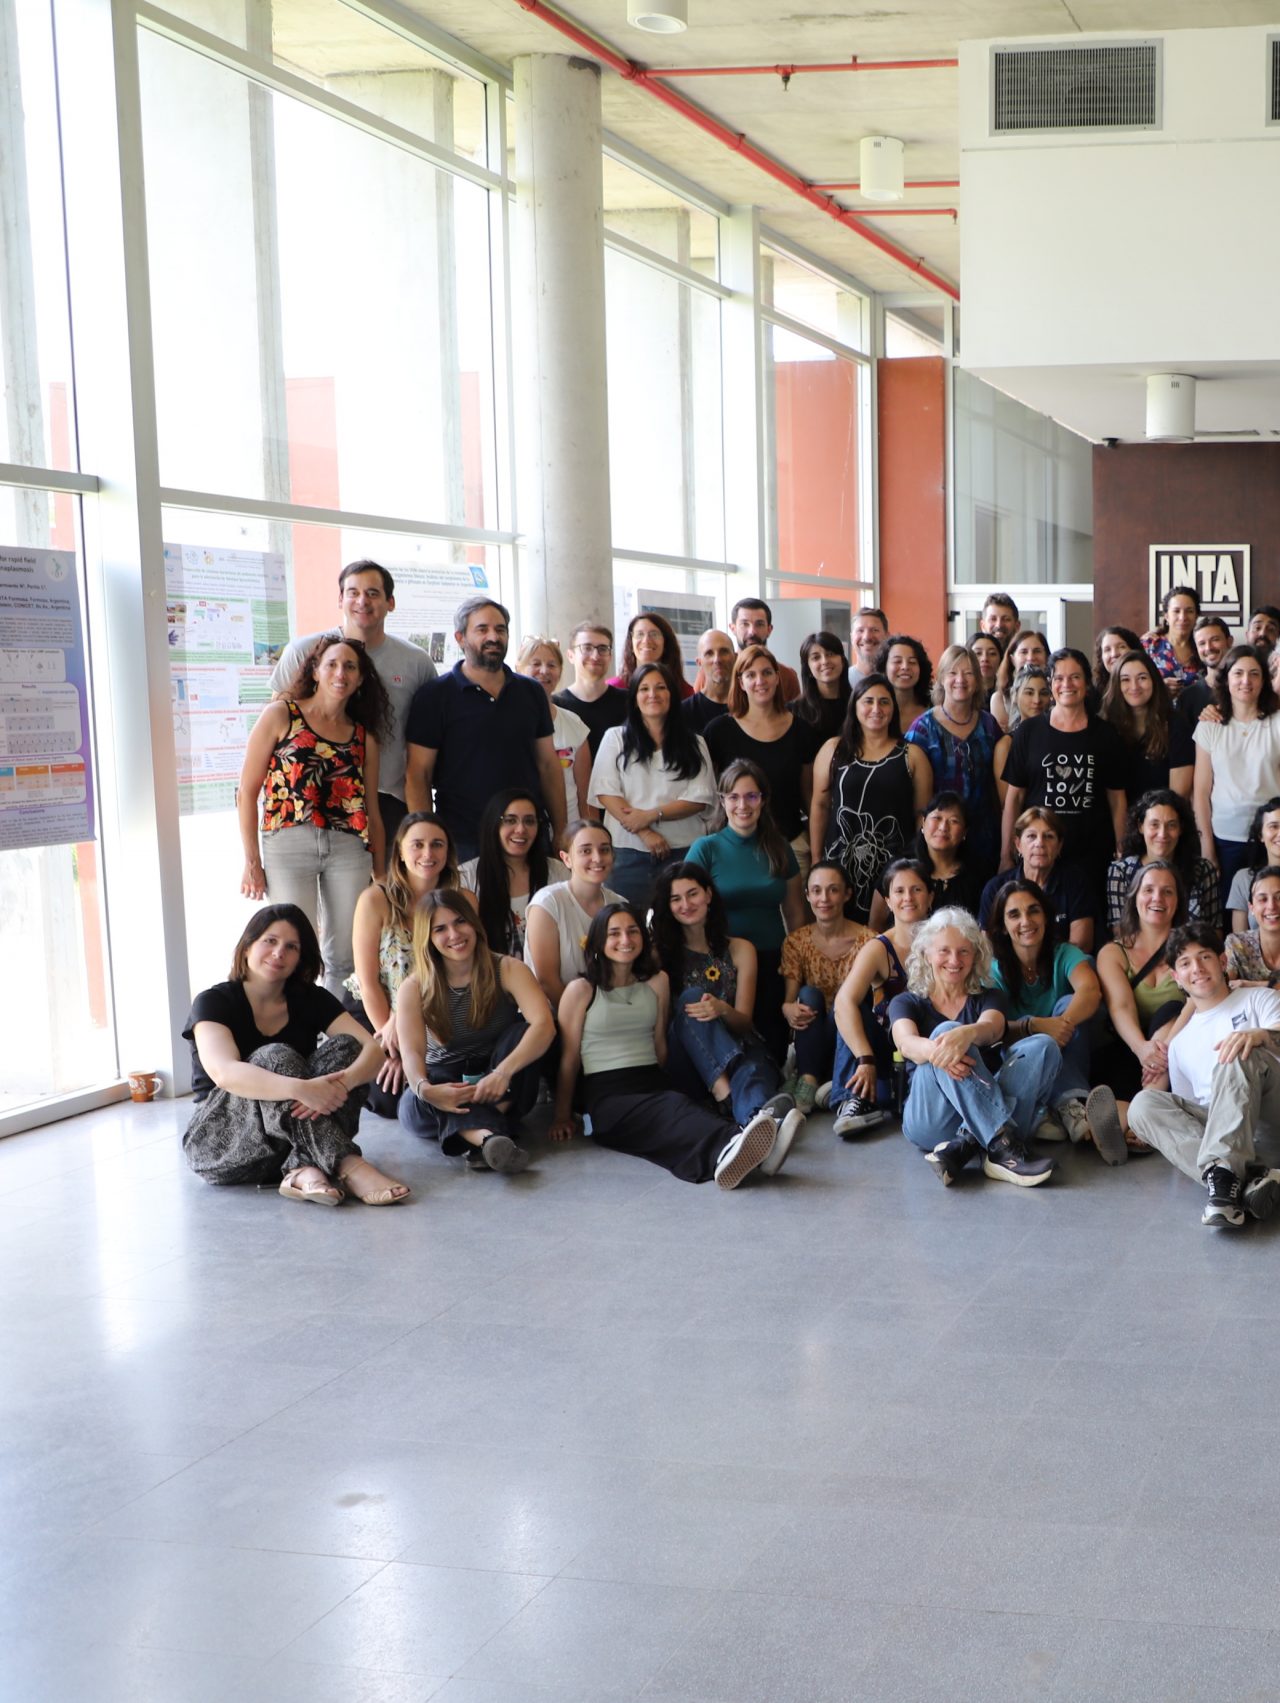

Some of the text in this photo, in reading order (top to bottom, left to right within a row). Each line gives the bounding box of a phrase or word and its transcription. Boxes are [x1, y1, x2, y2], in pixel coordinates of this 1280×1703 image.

[1160, 554, 1240, 603] INTA
[1042, 753, 1095, 767] LOVE
[1046, 779, 1093, 795] LOVE
[1044, 795, 1095, 808] LOVE
